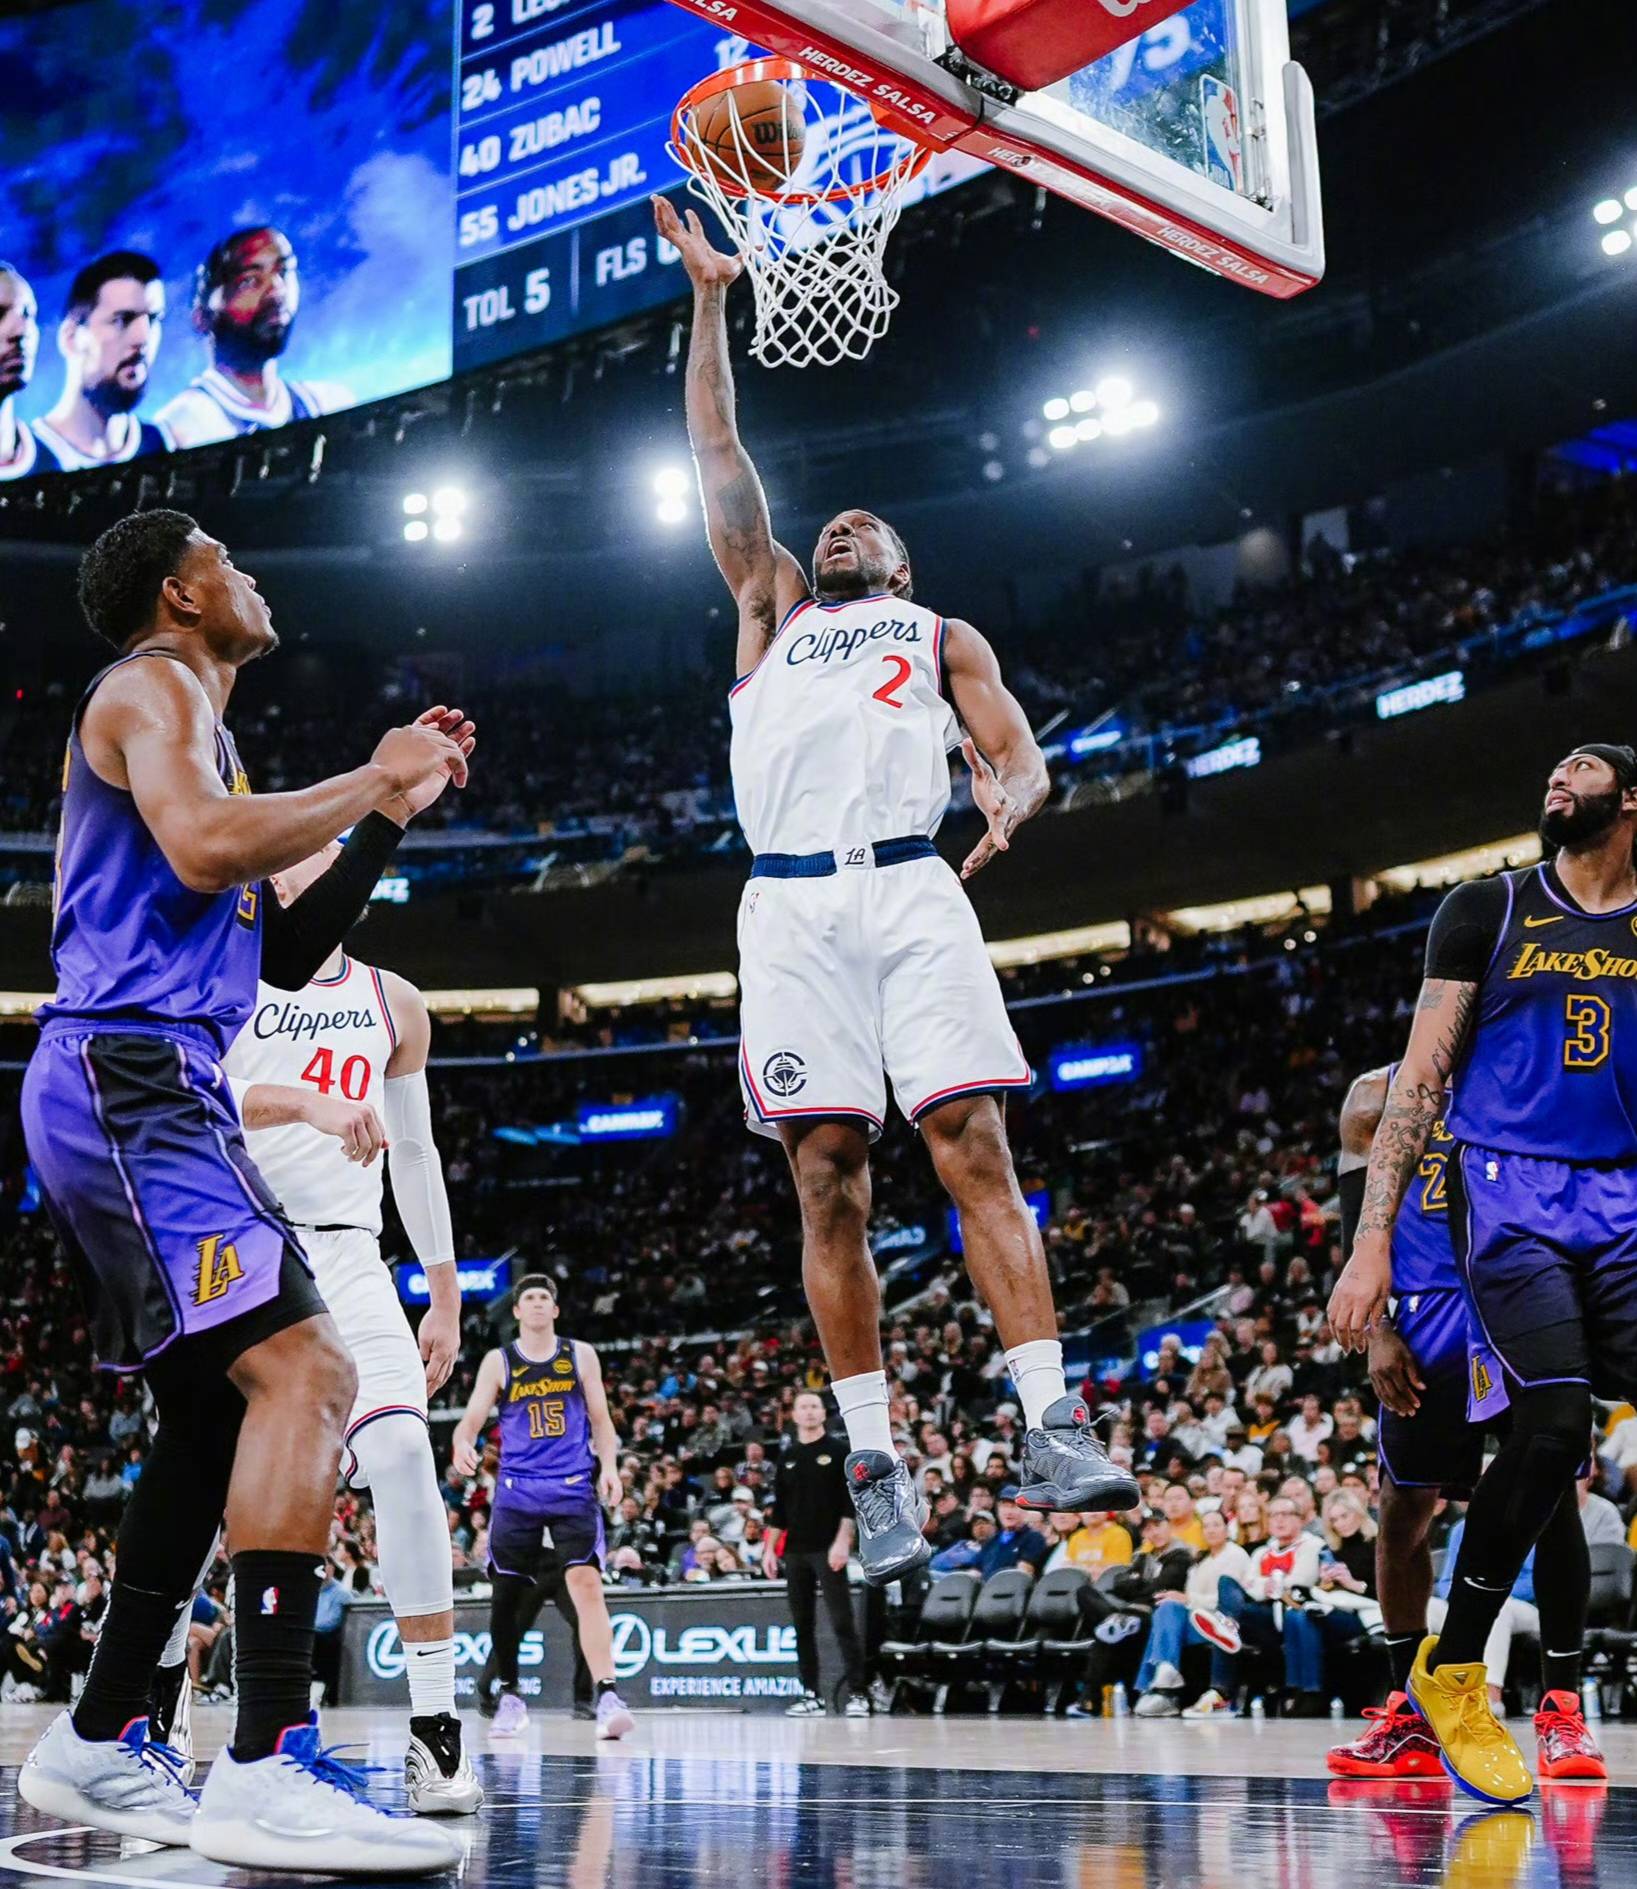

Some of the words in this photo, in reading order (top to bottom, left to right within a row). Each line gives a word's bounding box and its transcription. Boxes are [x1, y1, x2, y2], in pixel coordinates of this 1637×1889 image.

[471, 3, 494, 40] 2
[462, 68, 502, 111] 24
[510, 22, 621, 92] POWELL
[798, 46, 874, 87] HERDEZ
[872, 84, 935, 124] SALSA
[459, 136, 501, 176] 40
[508, 96, 600, 162] ZUBAC
[459, 205, 498, 247] 55
[507, 167, 599, 231] JONES
[599, 153, 647, 196] JR.
[595, 237, 646, 287] FLS
[1157, 226, 1219, 259] HERDEZ
[1216, 256, 1269, 284] SALSA
[463, 286, 515, 330] TOL
[524, 268, 550, 314] 5
[786, 618, 922, 666] Clippers
[872, 655, 912, 709] 2
[1507, 943, 1637, 981] LAKESHO
[254, 1003, 377, 1041] Clippers
[1564, 994, 1611, 1067] 3
[301, 1047, 371, 1101] 40
[188, 1232, 246, 1307] LA
[528, 1400, 566, 1439] 15
[651, 1676, 741, 1696] EXPERIENCE
[743, 1677, 805, 1696] AMAZIN
